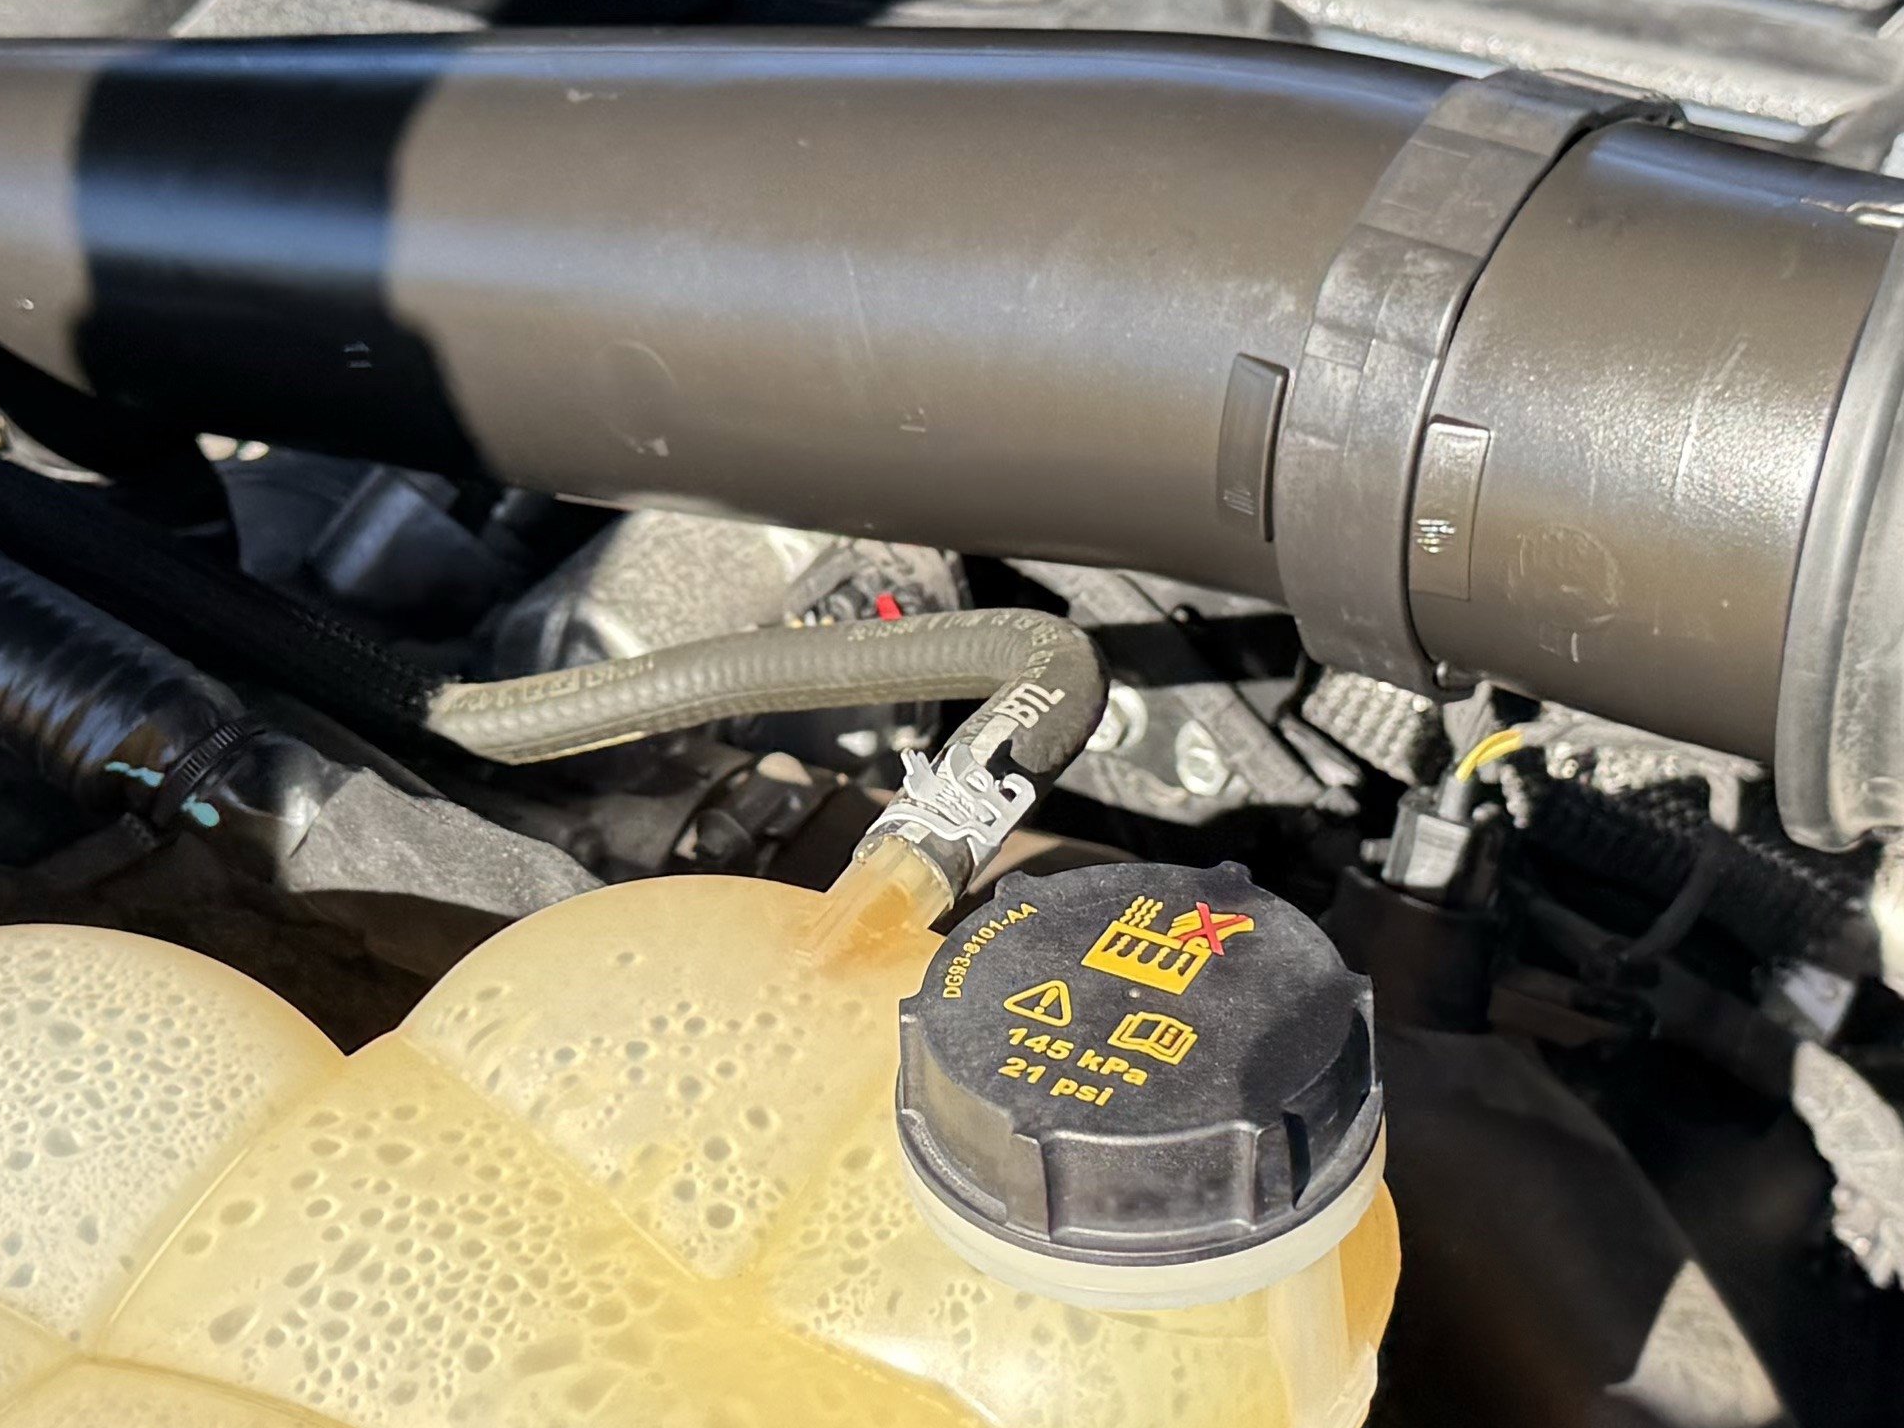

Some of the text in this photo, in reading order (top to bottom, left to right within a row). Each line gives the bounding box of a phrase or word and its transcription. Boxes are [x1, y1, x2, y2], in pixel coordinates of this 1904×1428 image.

[998, 1057, 1114, 1107] 21 psi
[1008, 1027, 1148, 1086] 145 kPa
